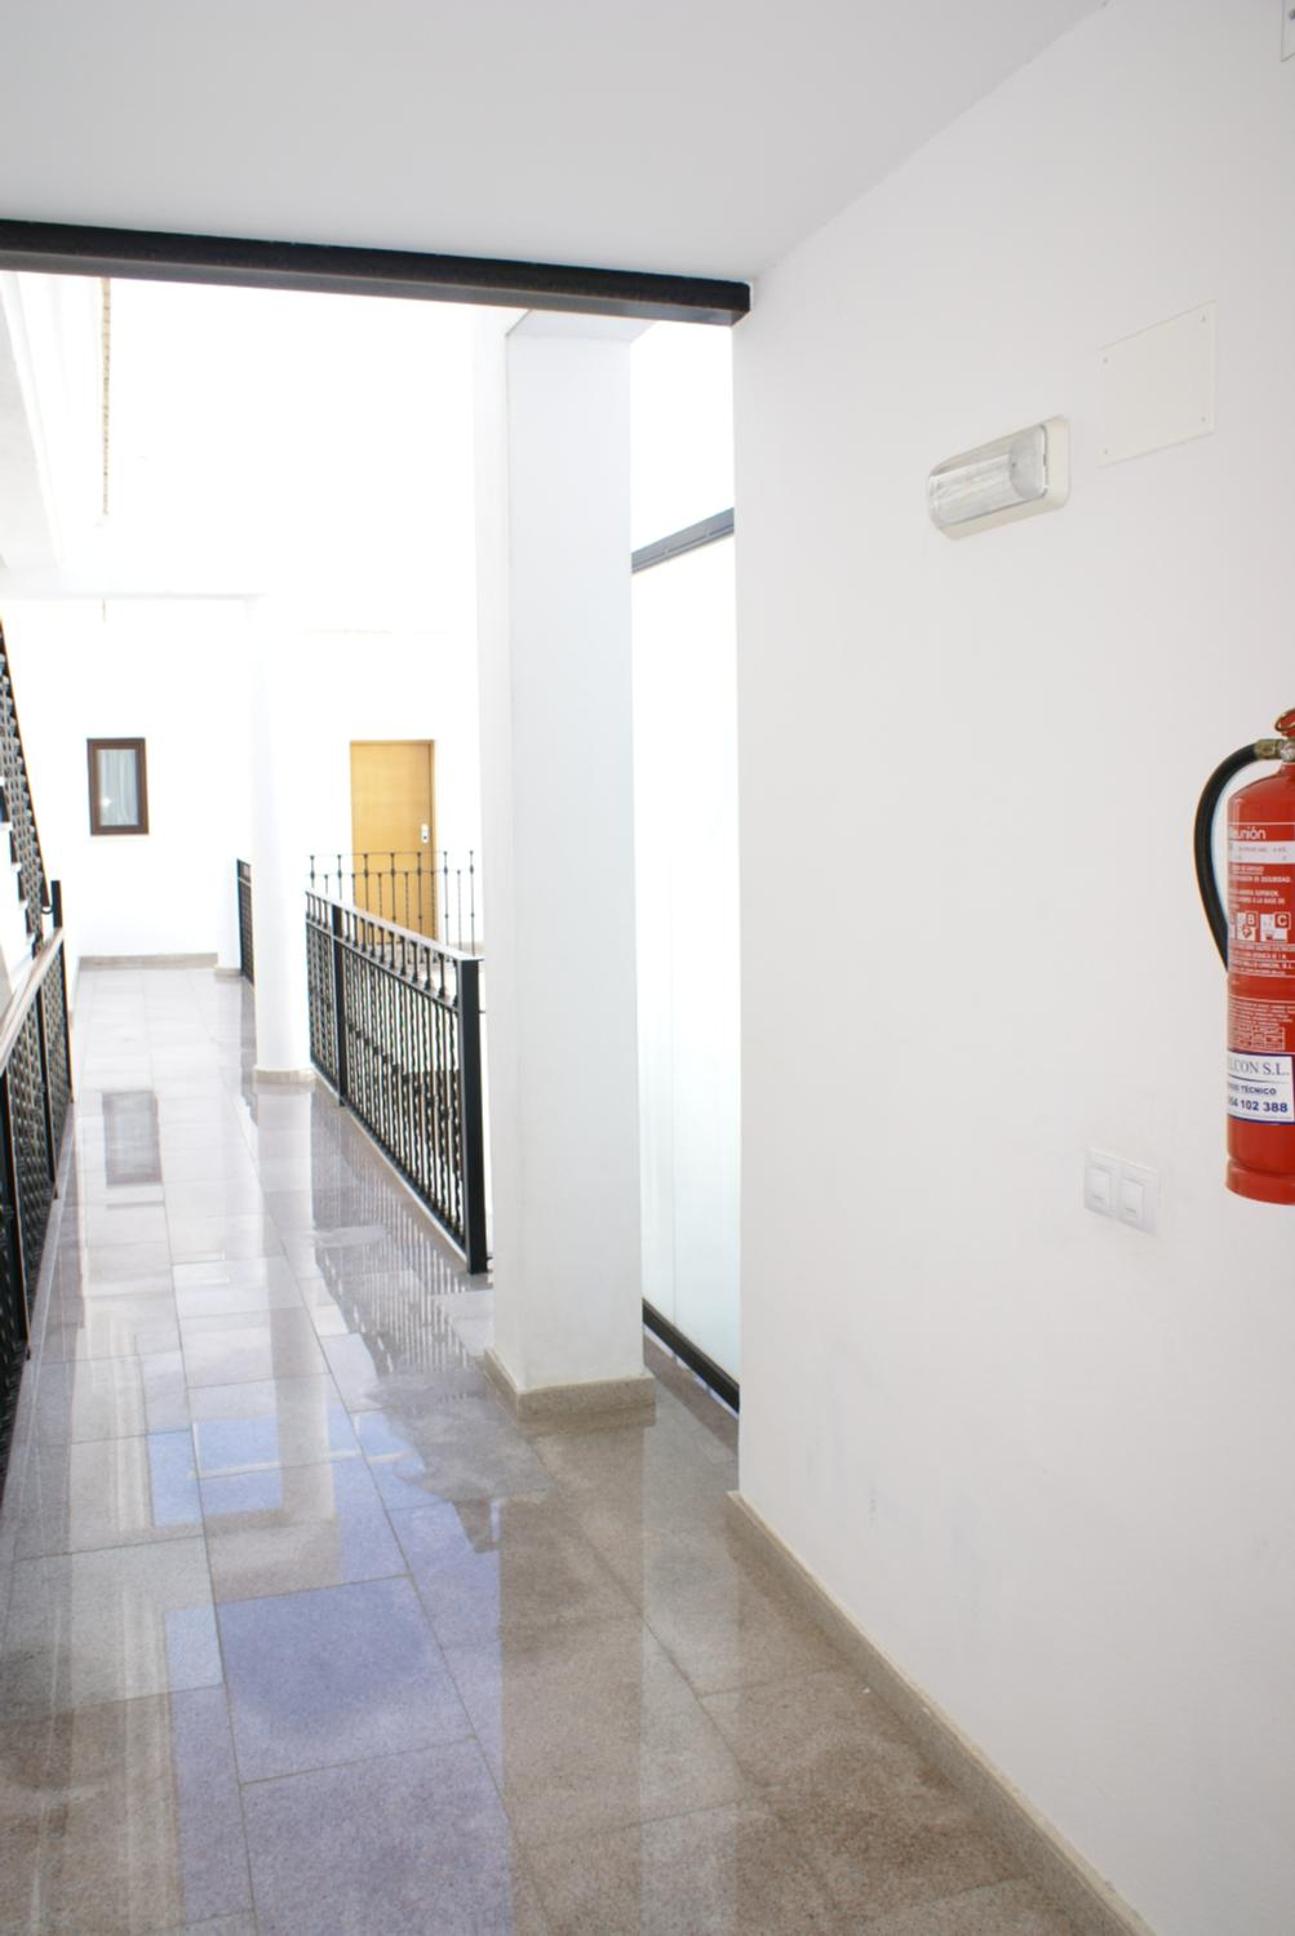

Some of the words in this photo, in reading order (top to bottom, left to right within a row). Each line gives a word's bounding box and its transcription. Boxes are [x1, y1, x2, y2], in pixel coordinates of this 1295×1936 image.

[1277, 914, 1287, 926] C
[1241, 1099, 1259, 1111] 102
[1263, 1101, 1288, 1113] 388
